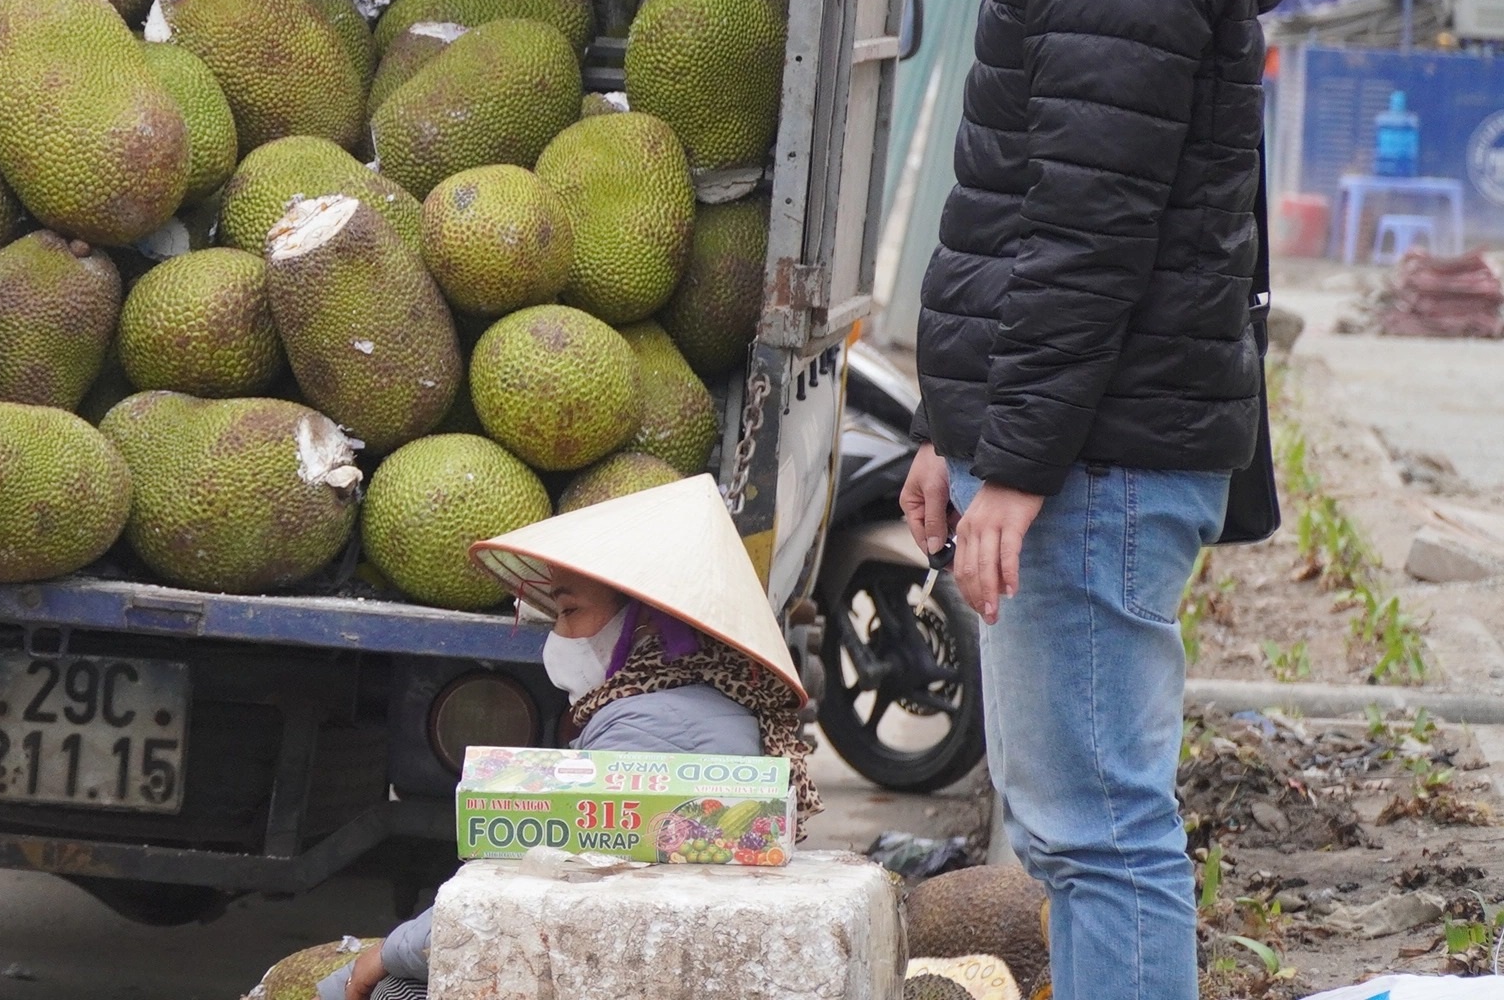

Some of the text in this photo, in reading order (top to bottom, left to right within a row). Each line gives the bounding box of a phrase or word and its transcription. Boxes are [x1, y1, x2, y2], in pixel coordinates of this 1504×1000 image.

[22, 658, 139, 728] 29C
[607, 760, 669, 774] WRAP
[676, 763, 779, 784] FOOD
[604, 772, 671, 792] 315
[466, 798, 551, 812] DUY ANH SAIGON
[576, 798, 642, 831] 315
[468, 816, 571, 850] FOOD
[577, 831, 641, 850] WRAP
